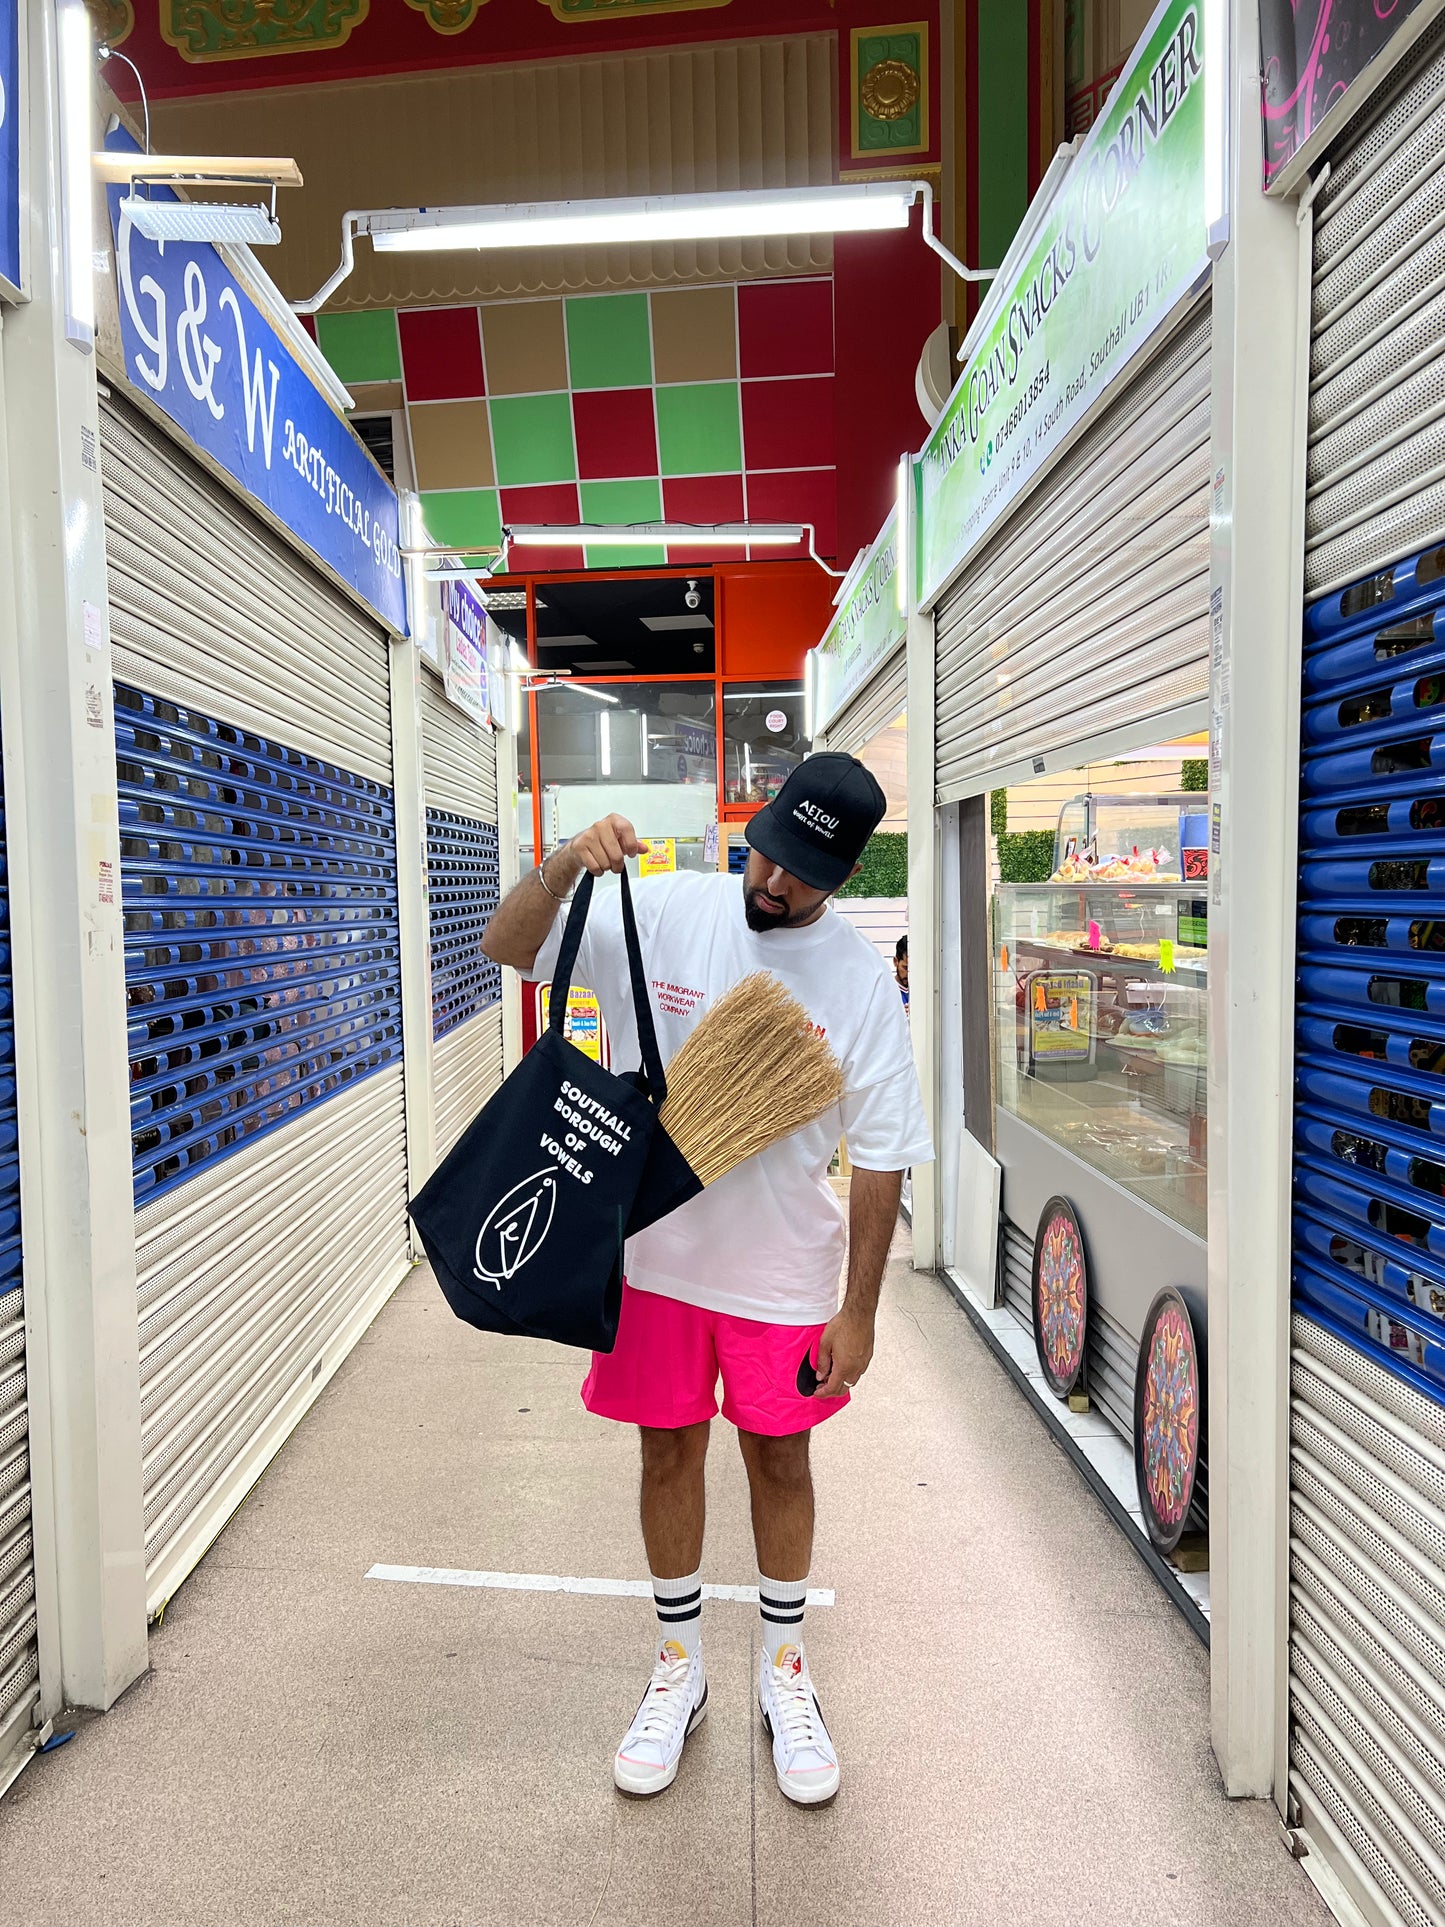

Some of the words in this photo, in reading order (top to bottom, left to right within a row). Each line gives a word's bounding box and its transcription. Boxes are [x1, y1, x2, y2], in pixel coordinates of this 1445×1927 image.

[968, 333, 1006, 444] GOAN
[1008, 214, 1076, 386] SNACKS
[1083, 11, 1202, 262] CORNER
[1043, 394, 1064, 436] South
[1065, 363, 1087, 409] Road,
[1089, 308, 1127, 378] Southall
[1129, 279, 1149, 326] UB1
[176, 260, 225, 420] &
[218, 286, 280, 471] W
[282, 418, 371, 548] ARTIFICIAL
[373, 521, 401, 579] GOLD
[799, 800, 840, 829] AEIOU
[651, 980, 666, 990] THE
[667, 983, 706, 1000] IMMIGRANT
[657, 992, 695, 1008] WORKWEAR
[659, 1003, 690, 1017] COMPANY
[553, 1097, 623, 1156] BOROUGH
[560, 1080, 632, 1142] SOUTHALL
[539, 1132, 594, 1185] VOWELS
[564, 1132, 588, 1152] OF
